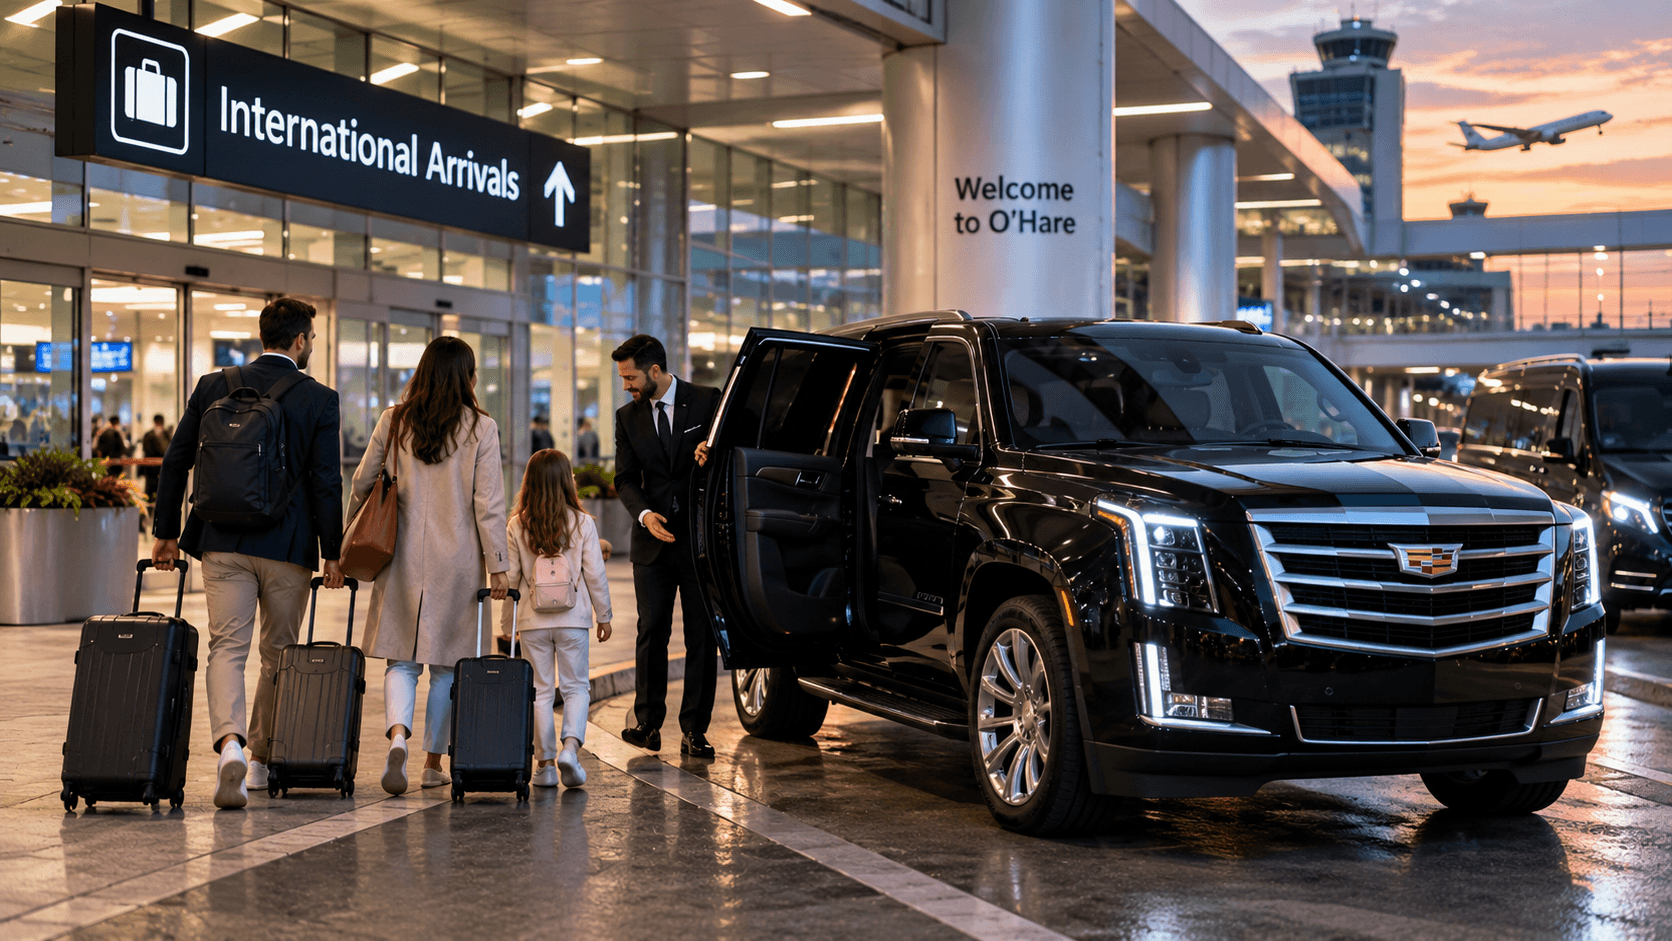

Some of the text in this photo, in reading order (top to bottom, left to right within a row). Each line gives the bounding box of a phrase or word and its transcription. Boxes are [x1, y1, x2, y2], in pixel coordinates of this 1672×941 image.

[220, 85, 520, 201] International Arrivals
[954, 175, 1074, 201] Welcome
[954, 209, 1076, 234] to O'Hare
